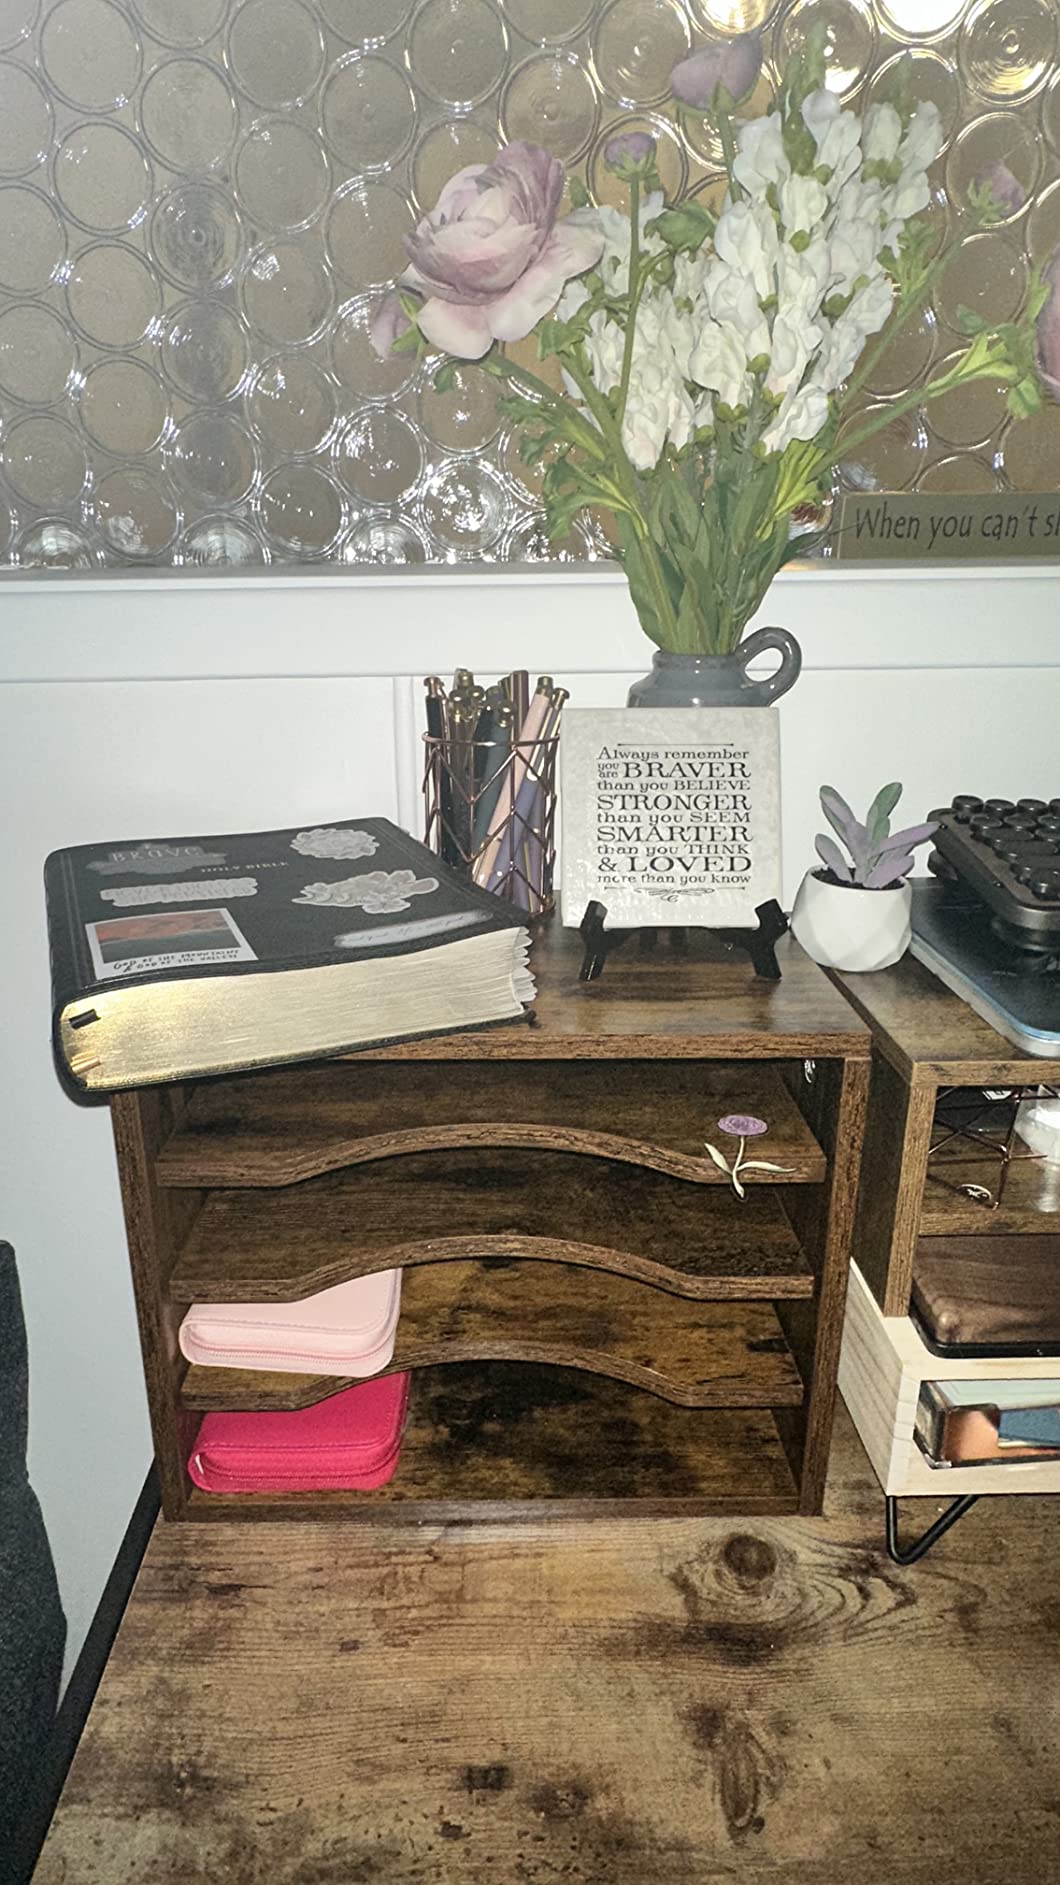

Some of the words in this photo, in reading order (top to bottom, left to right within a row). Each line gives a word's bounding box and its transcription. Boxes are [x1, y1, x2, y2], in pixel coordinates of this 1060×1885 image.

[856, 501, 920, 540] When
[928, 514, 972, 550] you
[981, 504, 1038, 541] can't
[596, 747, 660, 761] Always
[664, 749, 750, 760] remember
[598, 763, 619, 771] you
[599, 770, 618, 778] are
[623, 762, 751, 778] BRAVER
[597, 780, 634, 790] than
[640, 782, 668, 793] you
[674, 780, 751, 791] BELIEVE
[597, 794, 752, 810] STRONGER
[597, 813, 641, 823] than
[649, 814, 683, 825] you
[690, 812, 751, 823] SEEM
[597, 826, 753, 842] SMARTER
[597, 844, 638, 854] than
[646, 846, 679, 857] you
[684, 844, 750, 854] THINK
[598, 857, 618, 872] &
[628, 857, 752, 872] LOVED
[598, 875, 637, 883] more
[641, 874, 674, 883] than
[680, 876, 706, 886] you
[711, 874, 751, 883] know
